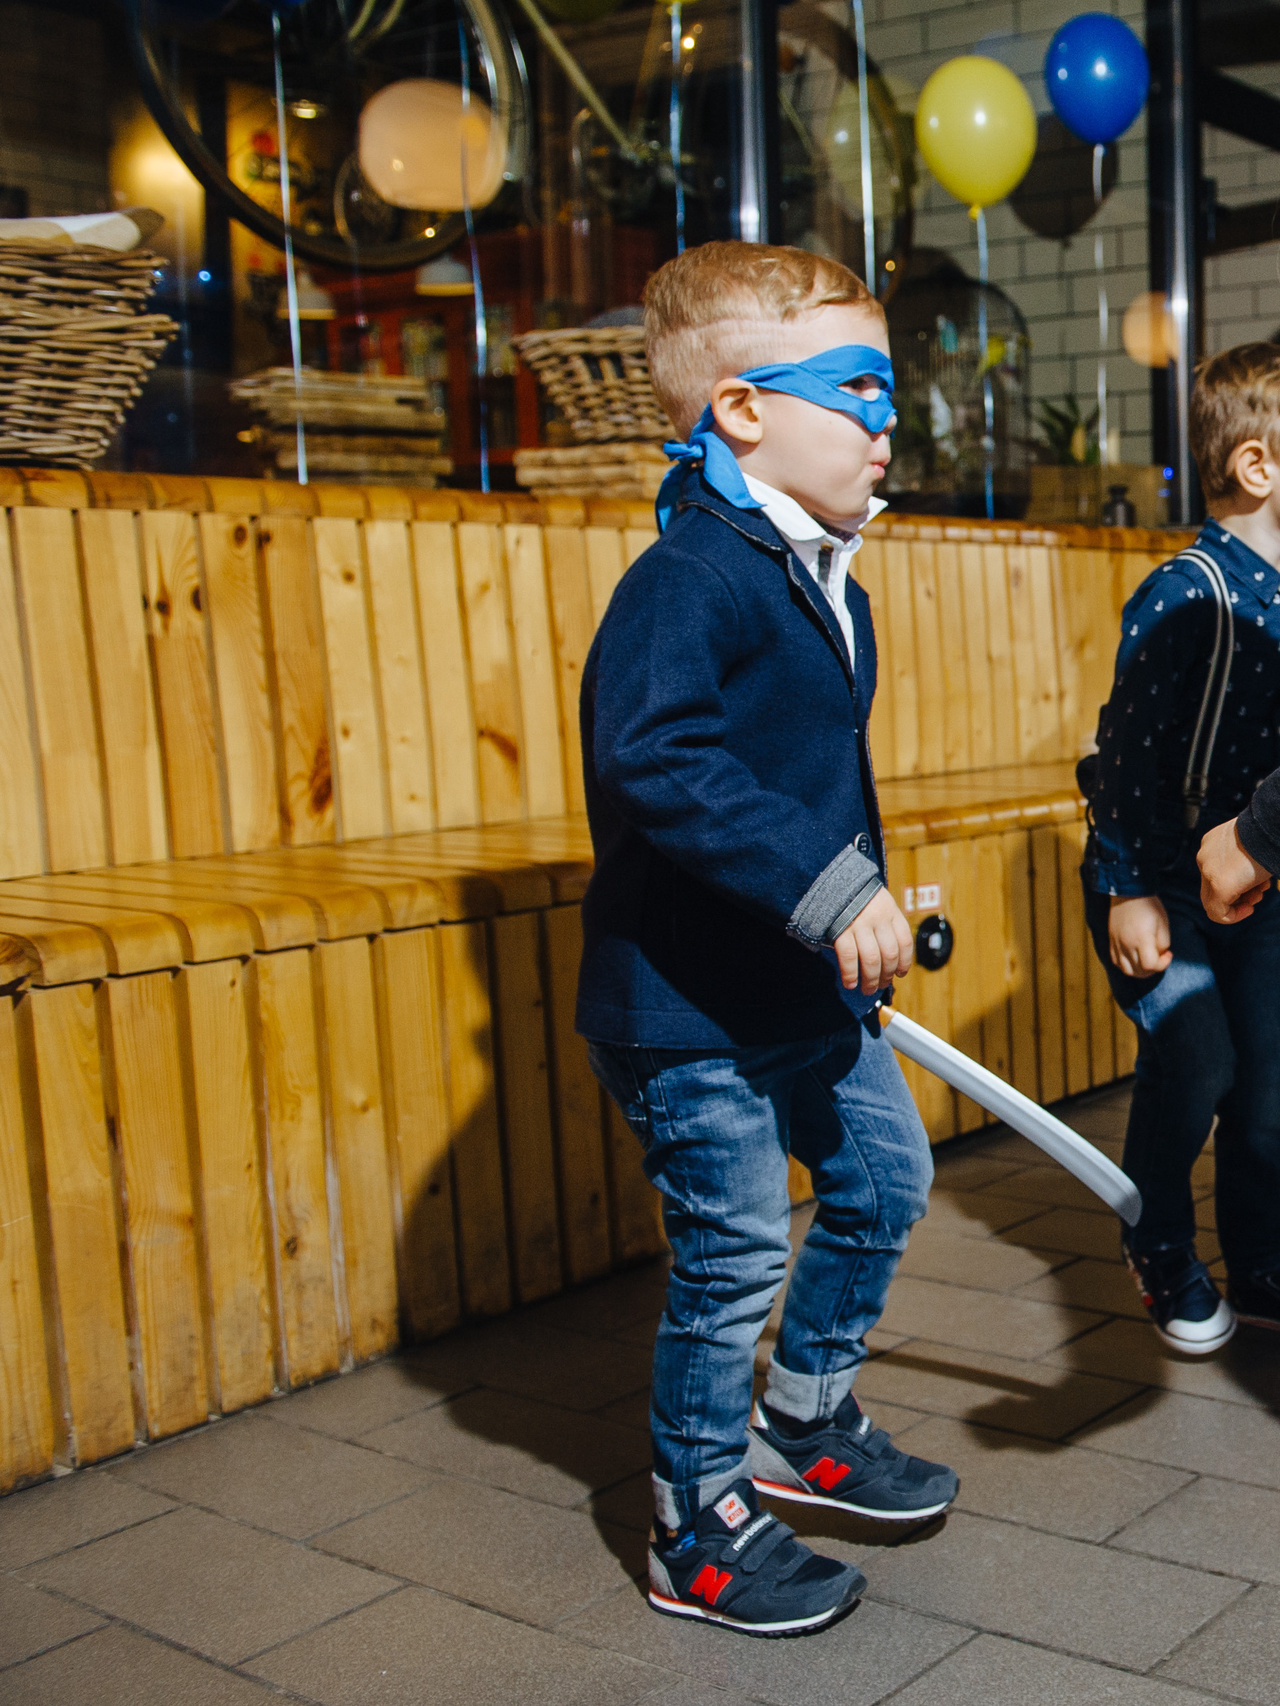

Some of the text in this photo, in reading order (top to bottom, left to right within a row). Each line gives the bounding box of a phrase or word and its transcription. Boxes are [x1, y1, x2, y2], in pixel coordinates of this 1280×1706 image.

[802, 1457, 851, 1490] N
[732, 1534, 749, 1551] new
[744, 1514, 772, 1536] balance
[690, 1564, 733, 1605] N
